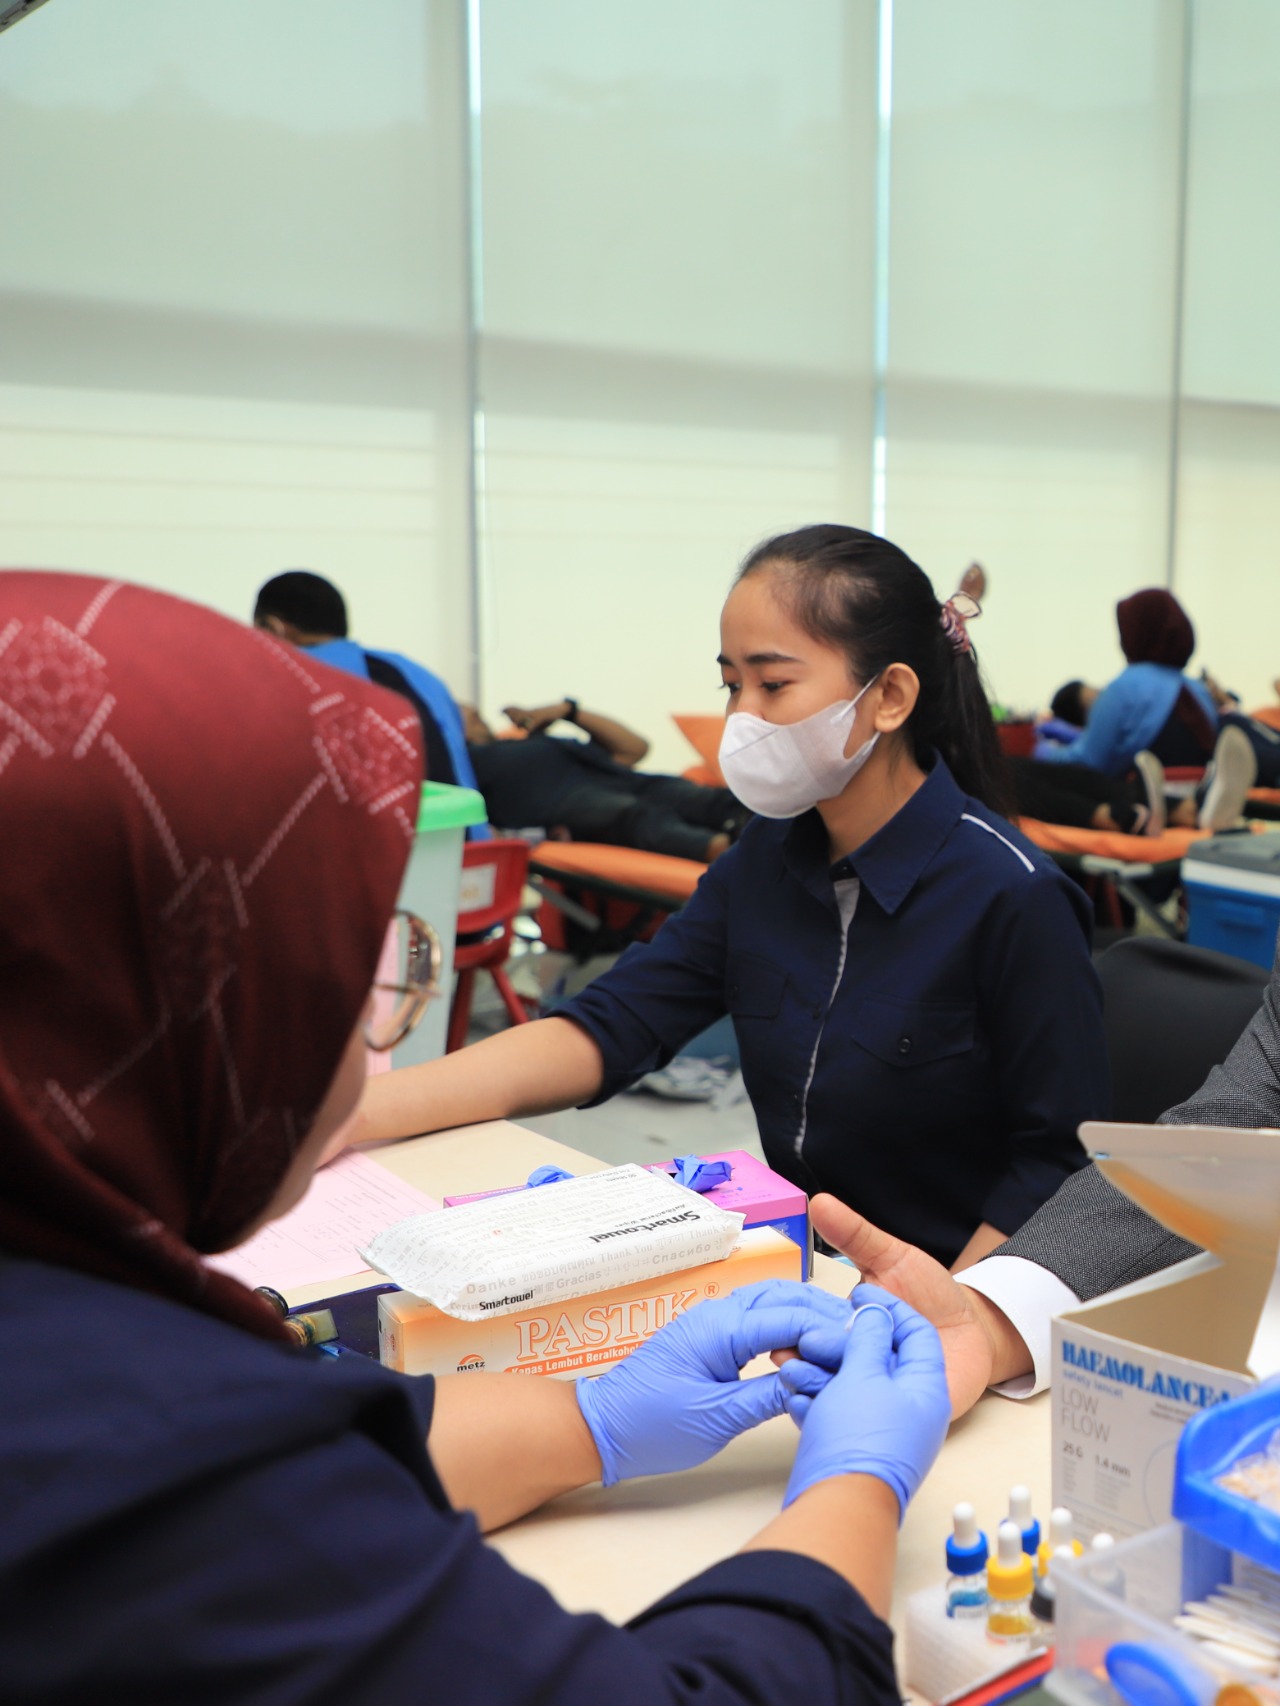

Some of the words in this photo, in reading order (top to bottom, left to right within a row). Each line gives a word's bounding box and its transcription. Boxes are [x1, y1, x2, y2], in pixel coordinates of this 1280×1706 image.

[588, 1210, 701, 1243] Smartowel
[598, 1247, 632, 1263] Thank
[634, 1242, 653, 1255] You
[651, 1241, 712, 1265] Спасибо
[465, 1274, 518, 1295] Danke
[555, 1269, 603, 1289] Gracias
[479, 1290, 534, 1311] Smartowel
[456, 1360, 486, 1372] metz
[546, 1357, 583, 1372] Lembut
[1063, 1370, 1091, 1389] safety
[1061, 1386, 1098, 1415] LOW
[1061, 1410, 1111, 1443] FLOW
